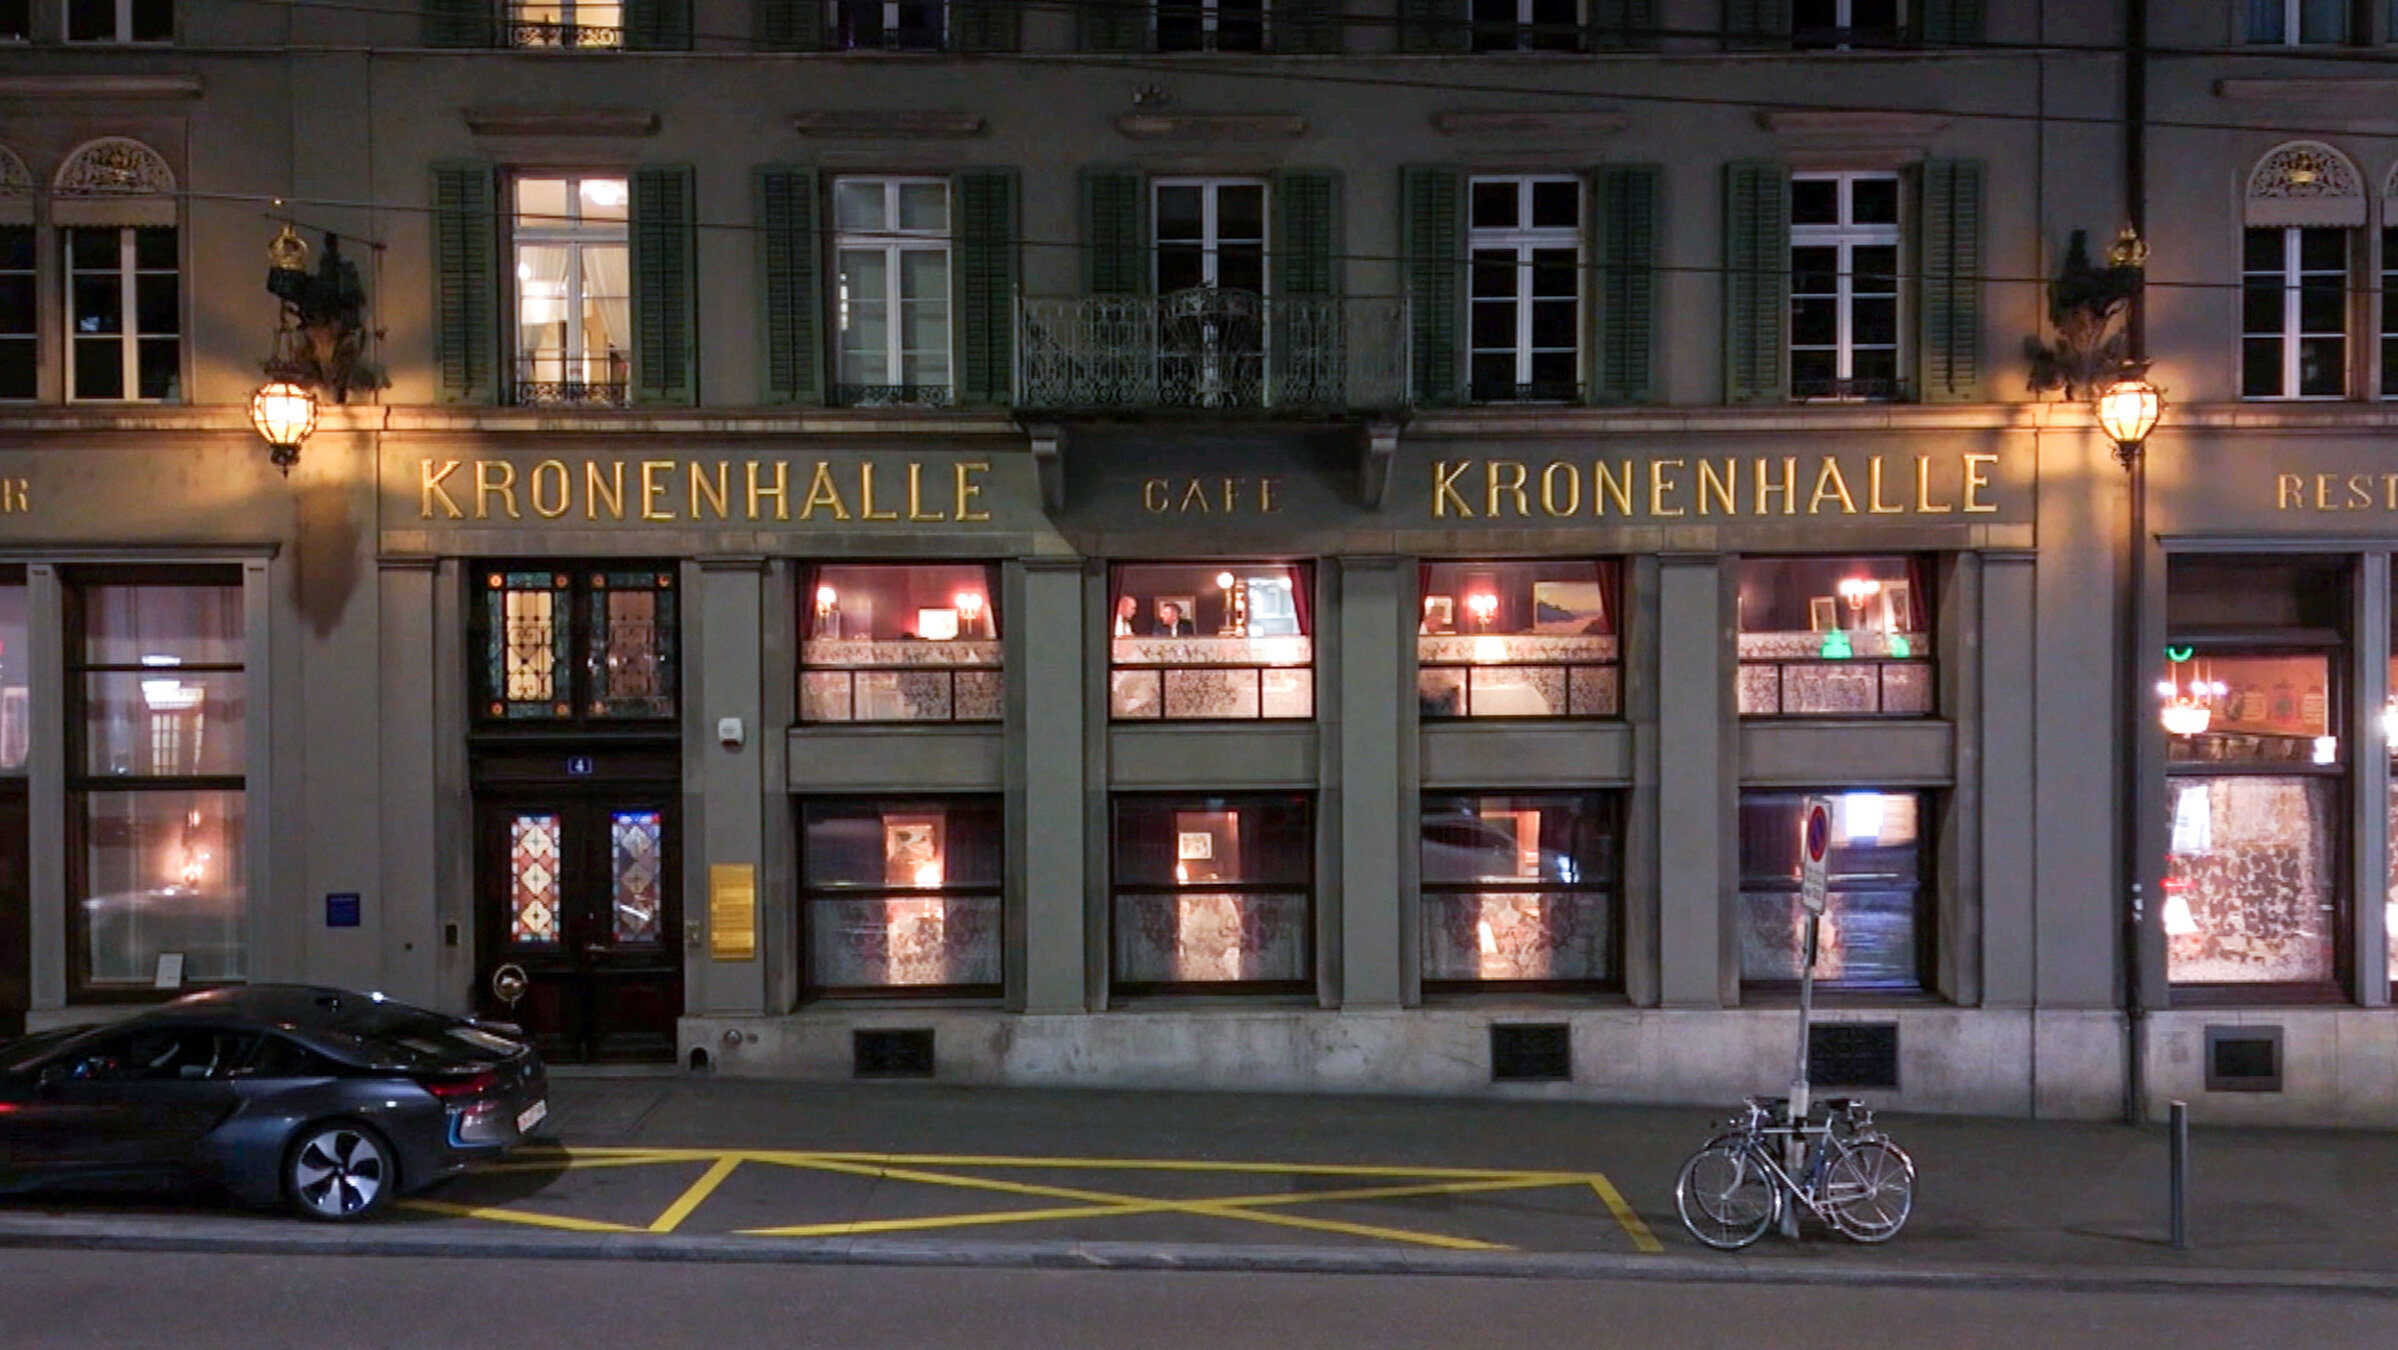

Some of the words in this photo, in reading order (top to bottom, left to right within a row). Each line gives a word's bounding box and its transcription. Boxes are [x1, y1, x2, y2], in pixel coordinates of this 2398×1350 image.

[419, 458, 991, 521] KRONENHALLE
[1433, 453, 1999, 518] KRONENHALLE
[574, 758, 585, 772] 4
